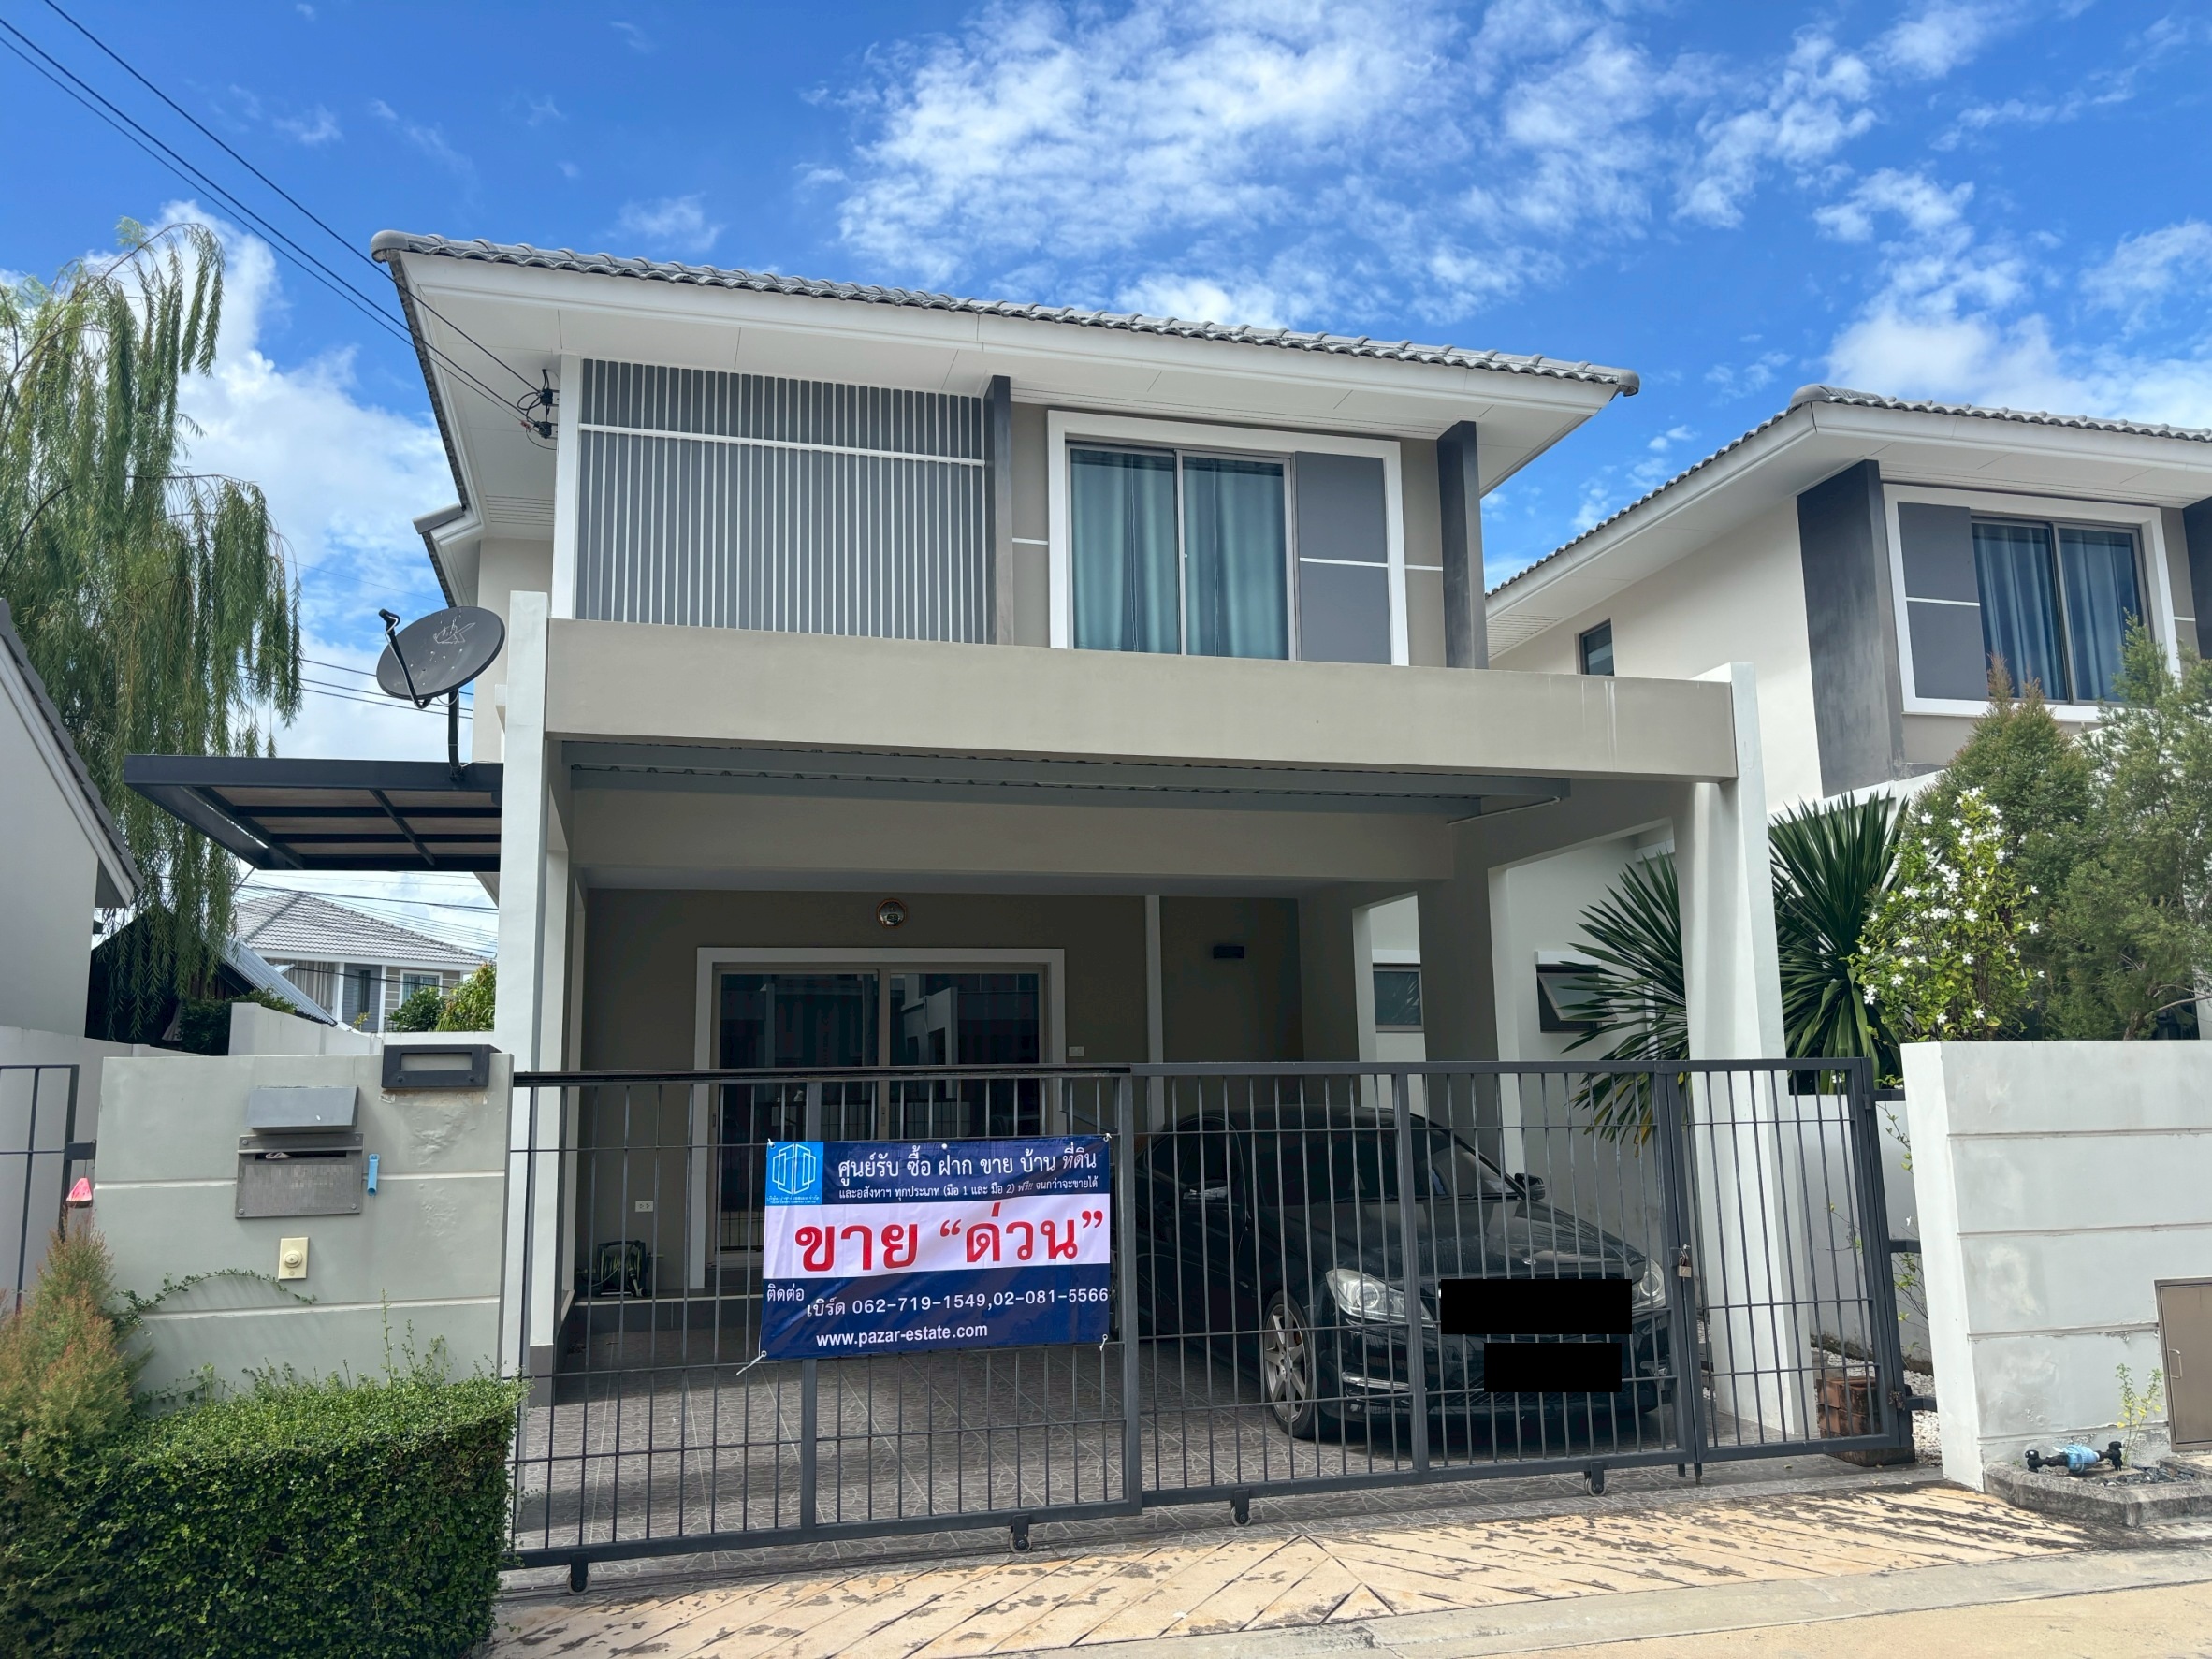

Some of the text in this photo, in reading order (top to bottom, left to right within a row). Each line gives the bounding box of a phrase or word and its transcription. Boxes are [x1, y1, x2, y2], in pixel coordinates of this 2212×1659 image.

[837, 1141, 1097, 1186] ศูนย์รับ ซื้อ ฝาก ขาย บ้าน ที่ดิน
[838, 1185, 892, 1199] และอสังหาฯ
[895, 1186, 940, 1201] ทุกประเภท
[943, 1183, 959, 1198] (มือ
[962, 1186, 968, 1196] 1
[971, 1186, 988, 1196] และ
[991, 1181, 1003, 1195] มือ
[1006, 1183, 1015, 1195] 2)
[1035, 1175, 1099, 1190] จนกว่าจะขายได้
[794, 1223, 919, 1272] ขาย
[766, 1283, 805, 1302] ติดต่อ
[807, 1288, 1109, 1317] เบิร์ด 062-719-1549,02-081-5566
